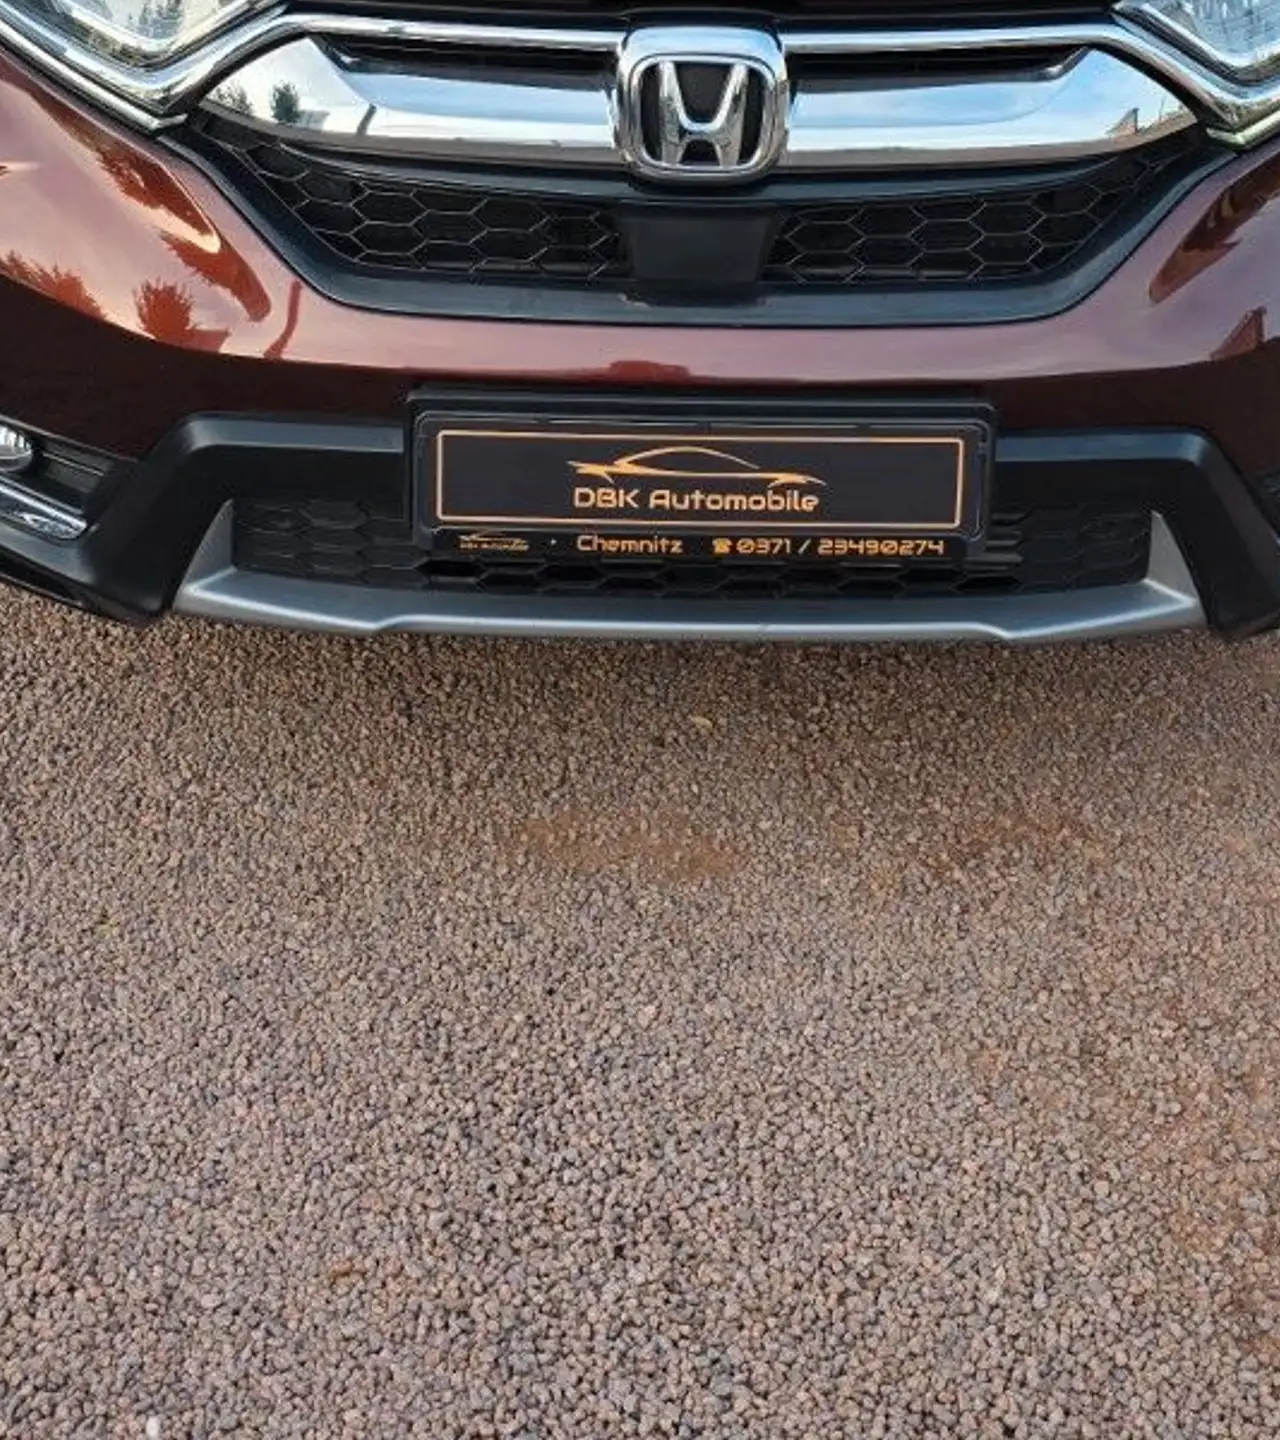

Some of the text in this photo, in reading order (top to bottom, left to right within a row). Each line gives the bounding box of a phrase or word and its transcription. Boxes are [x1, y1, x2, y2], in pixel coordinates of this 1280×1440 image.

[573, 486, 820, 512] DBK Automobile
[576, 534, 684, 554] Chemnitz
[736, 537, 791, 555] 0371
[817, 538, 945, 556] 23490274
